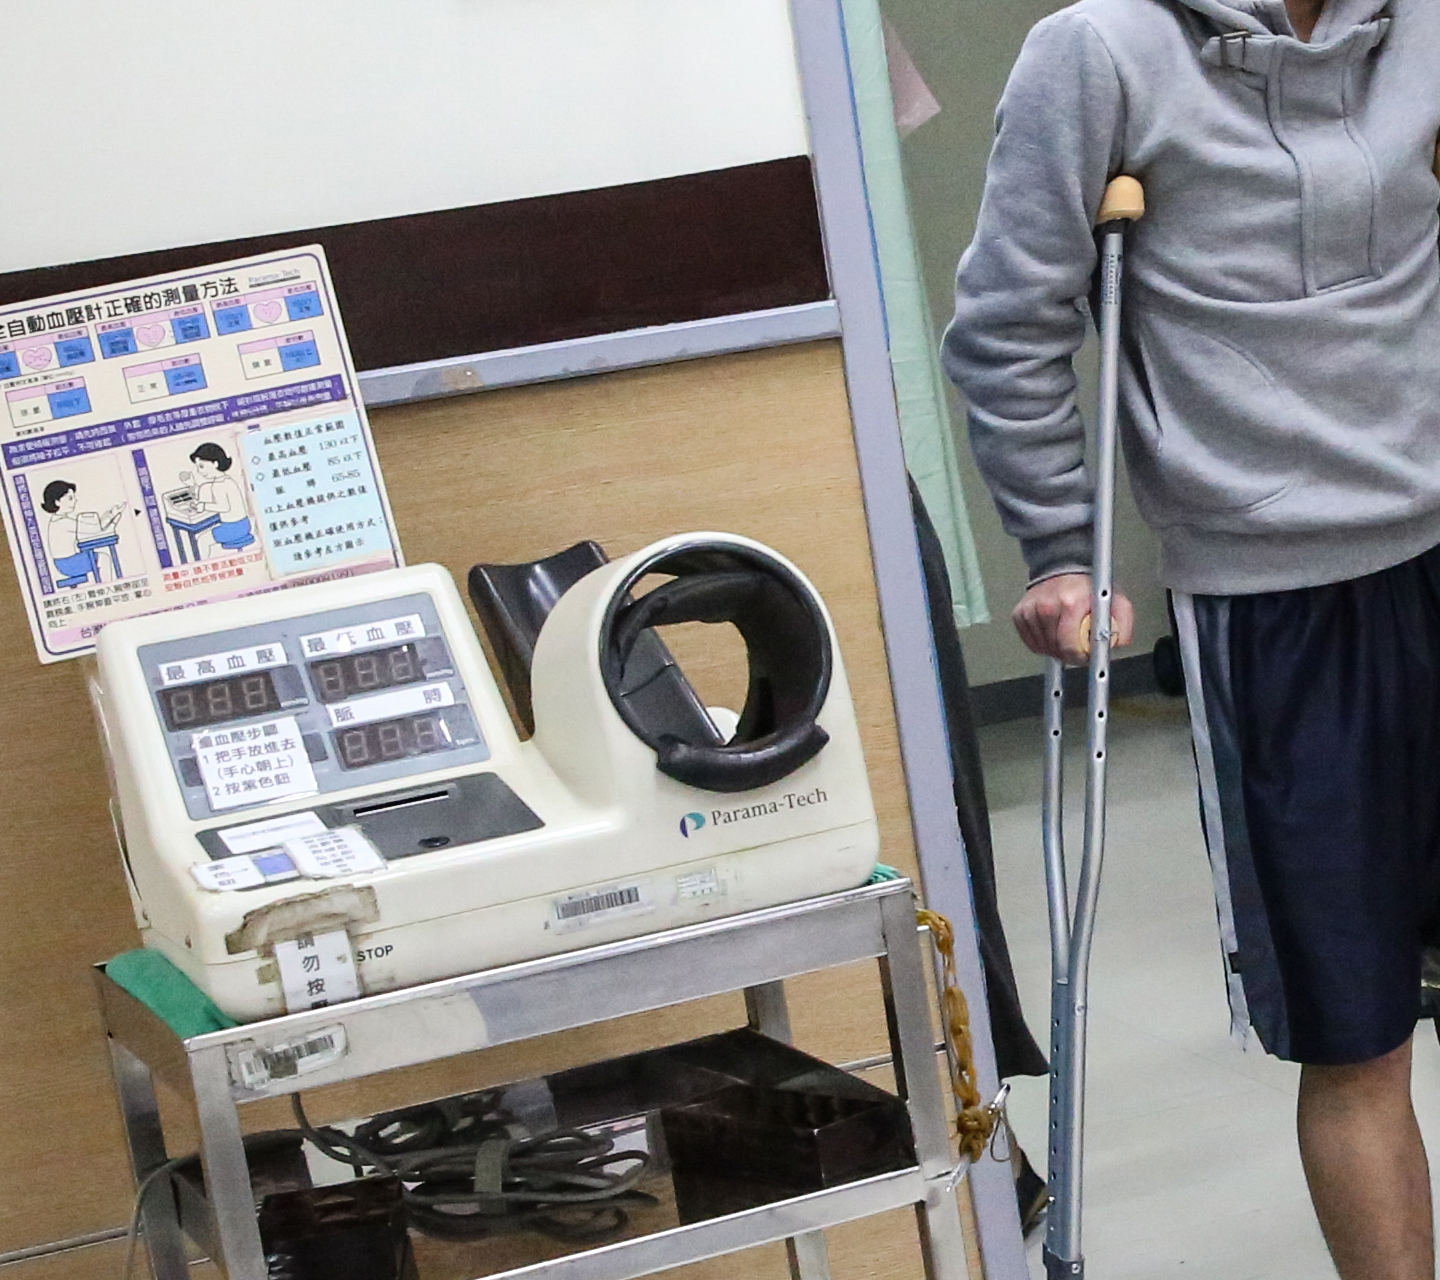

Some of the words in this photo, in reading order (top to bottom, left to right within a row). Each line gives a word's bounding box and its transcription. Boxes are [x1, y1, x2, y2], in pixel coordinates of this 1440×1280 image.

[165, 648, 277, 680] 最高血壓
[203, 754, 210, 765] 1
[214, 739, 297, 763] 把手放進去
[212, 785, 221, 797] 2
[711, 788, 828, 827] Parama-Tech
[357, 945, 394, 962] STOP
